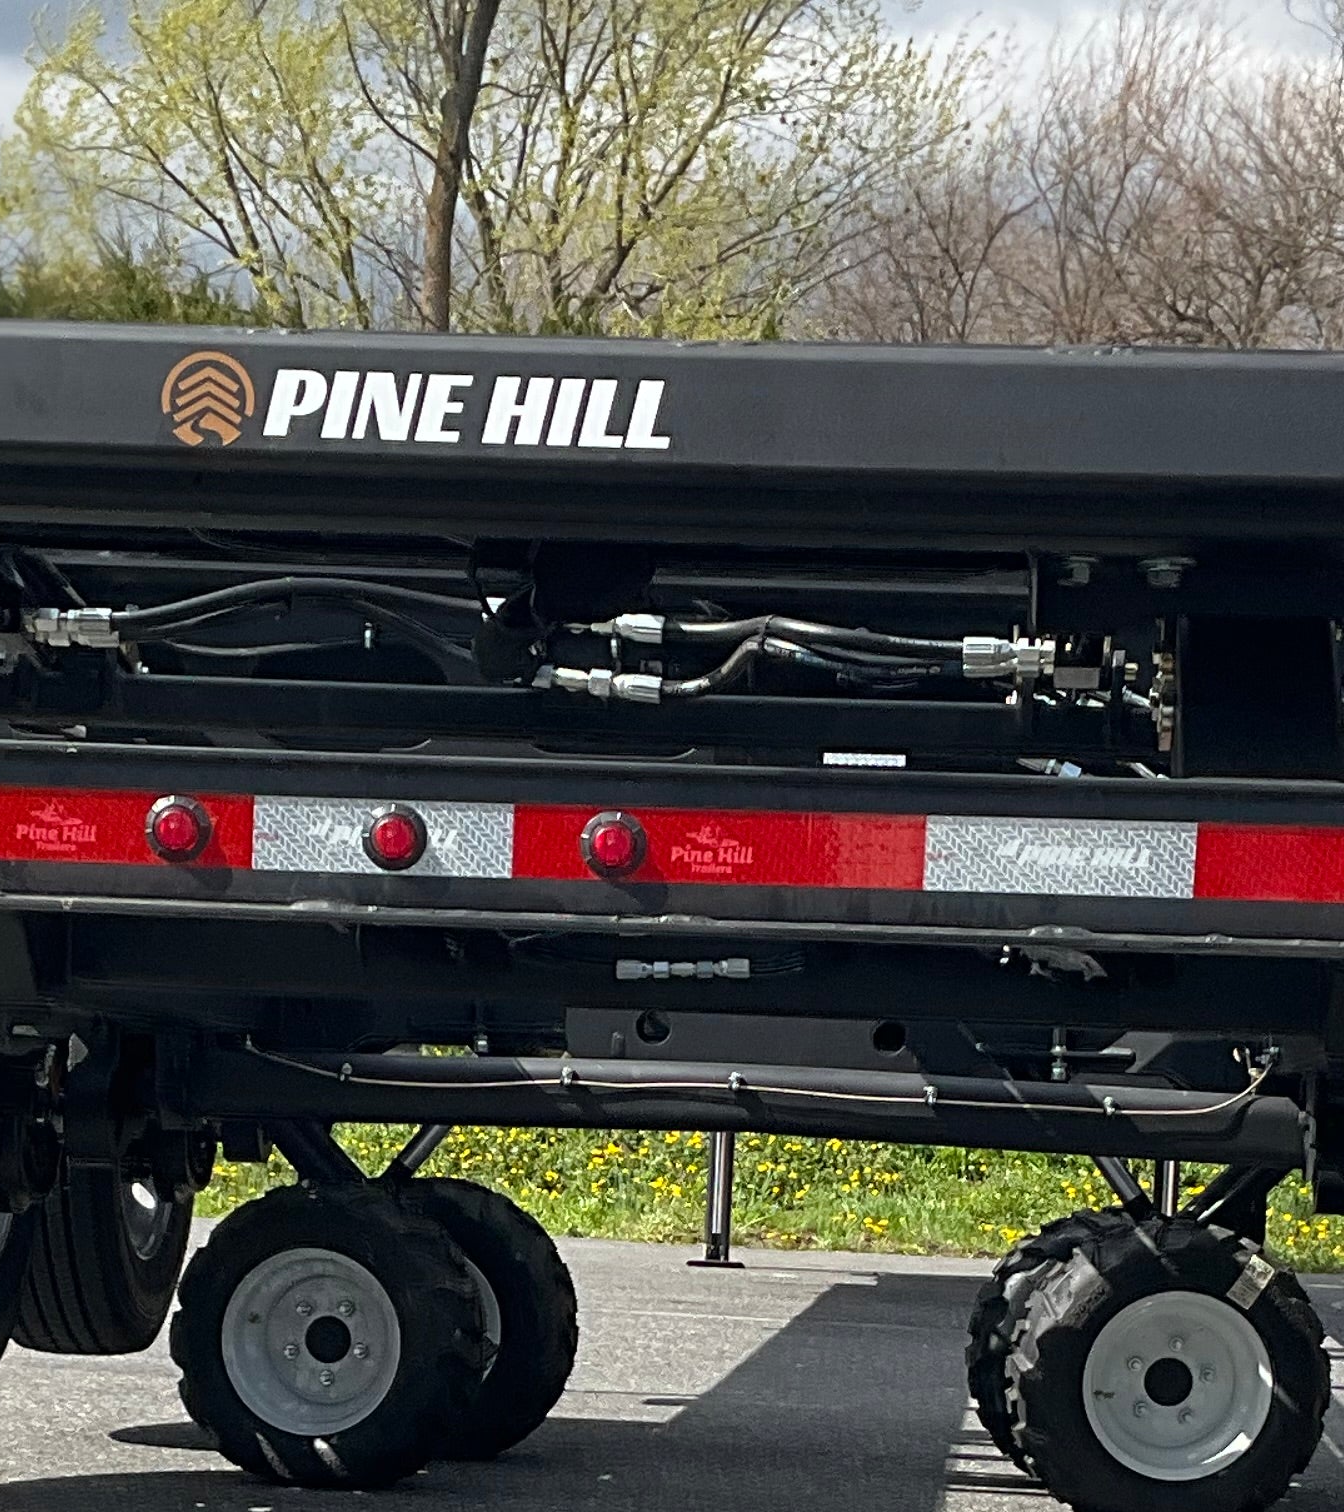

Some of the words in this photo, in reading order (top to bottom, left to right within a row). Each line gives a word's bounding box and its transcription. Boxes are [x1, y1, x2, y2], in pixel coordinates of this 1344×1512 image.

[262, 368, 474, 443] PINE
[480, 376, 672, 450] HILL
[16, 823, 58, 840] Pine
[62, 824, 97, 842] Hill
[671, 844, 713, 862] Pine
[717, 846, 754, 864] Hill
